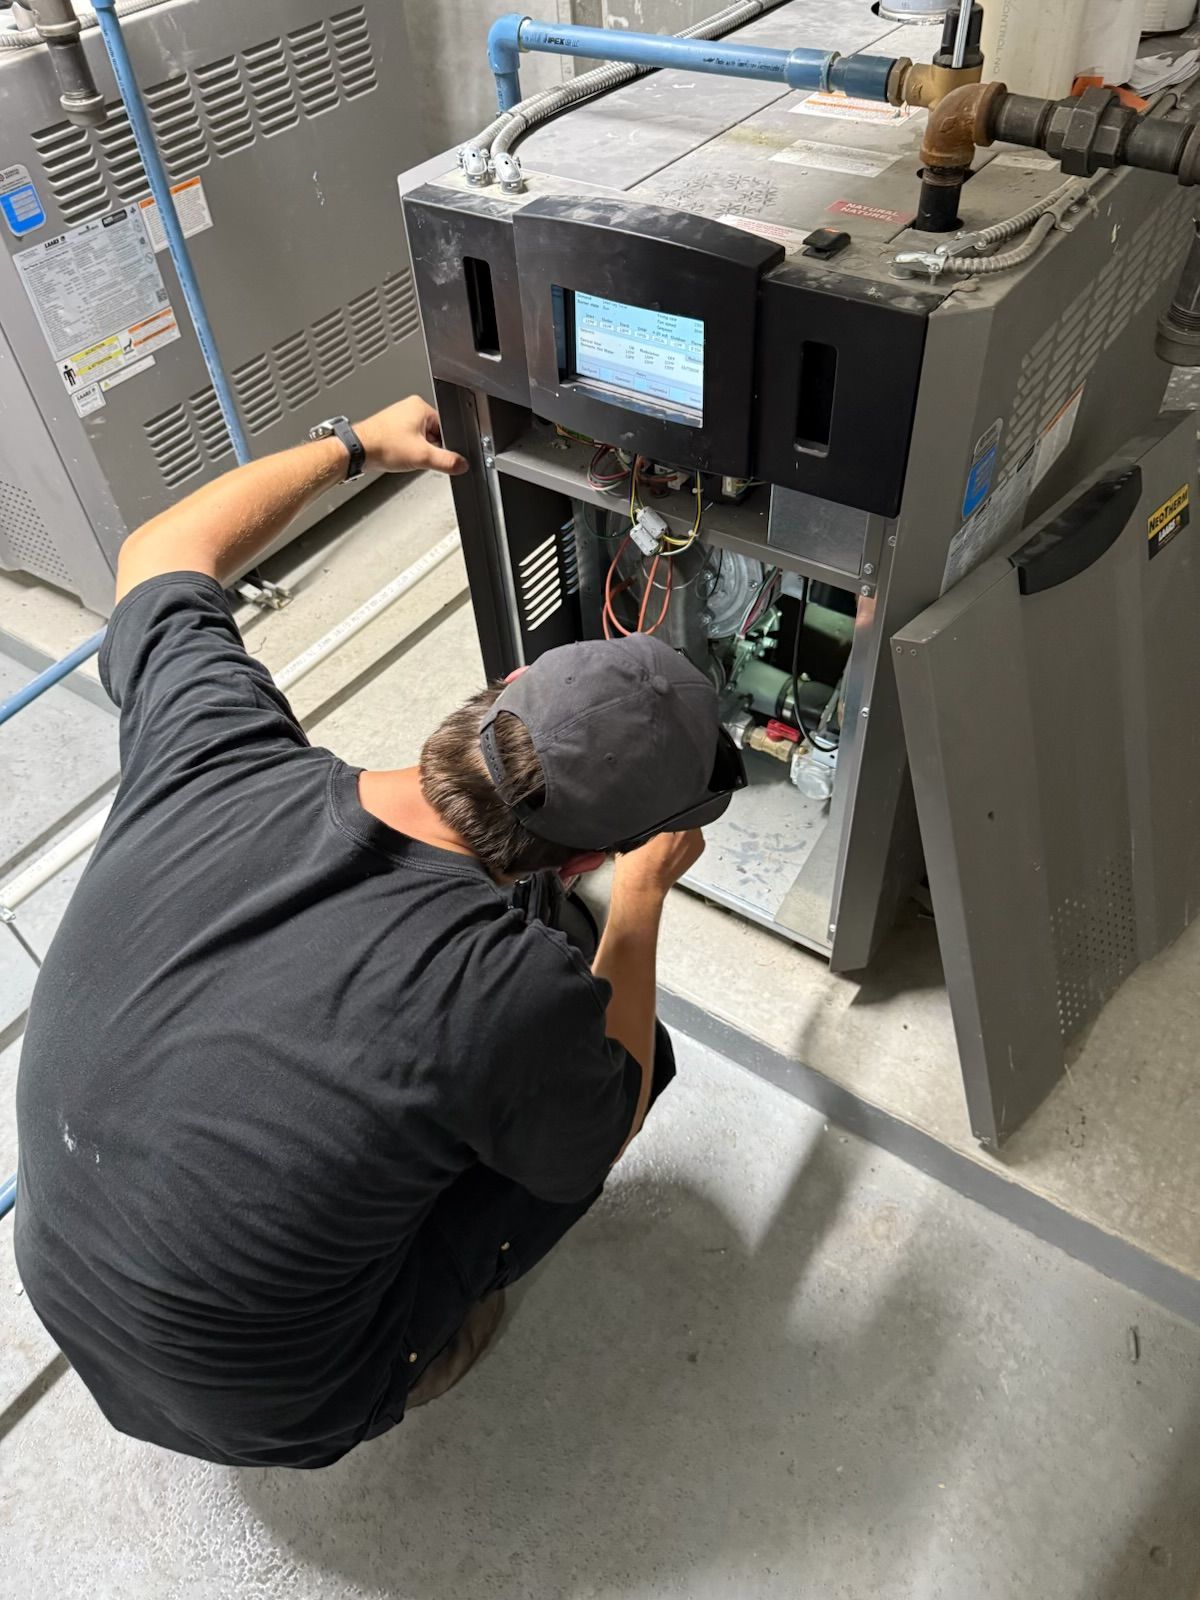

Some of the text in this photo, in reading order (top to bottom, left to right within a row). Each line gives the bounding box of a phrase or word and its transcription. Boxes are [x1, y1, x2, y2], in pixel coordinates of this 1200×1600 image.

[547, 37, 565, 46] IPEX
[839, 206, 894, 222] NATUREL
[846, 202, 899, 217] NATURAL
[1148, 490, 1189, 533] NEOTHERM
